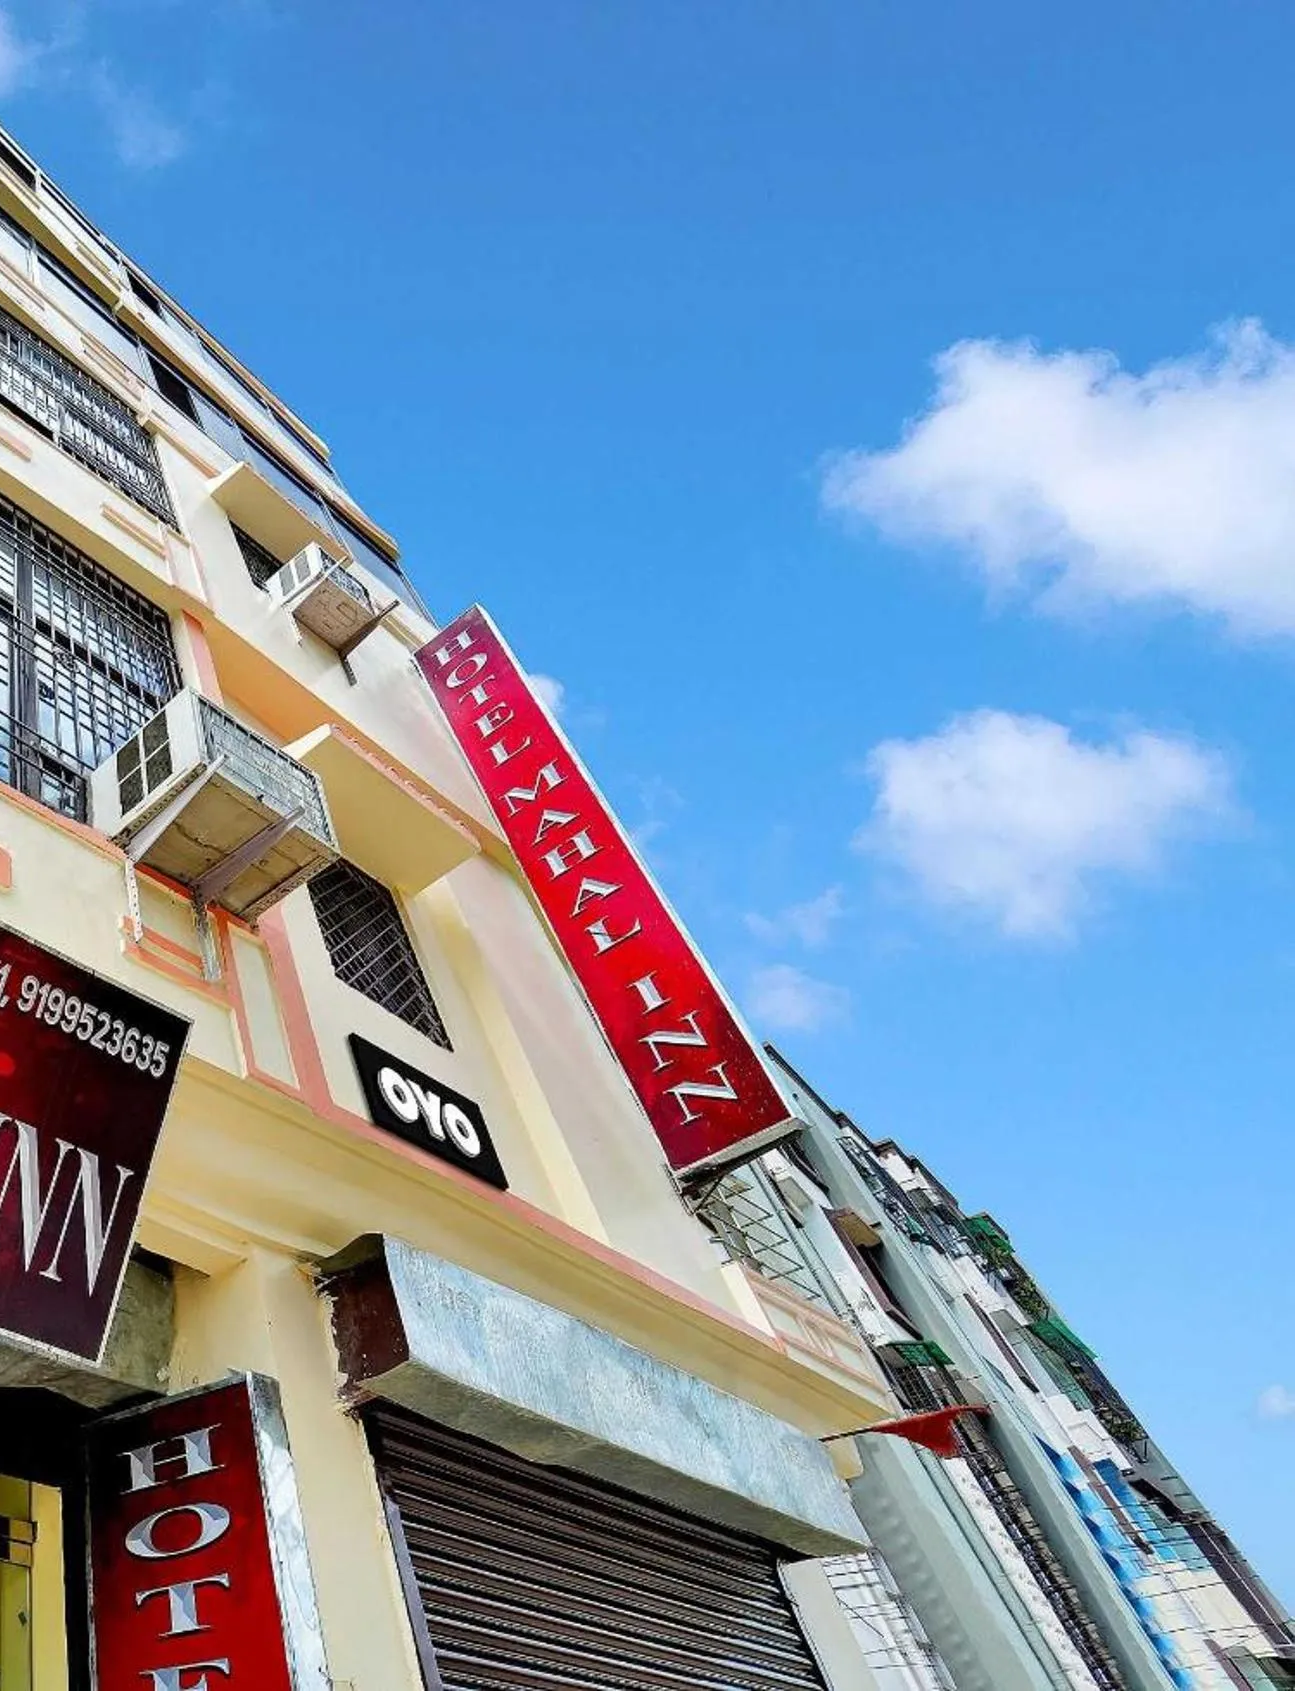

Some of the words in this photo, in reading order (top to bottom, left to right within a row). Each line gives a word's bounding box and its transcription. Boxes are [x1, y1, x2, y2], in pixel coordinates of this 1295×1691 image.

[431, 628, 530, 767] HOTEL
[500, 761, 641, 956] MAHAL
[626, 971, 738, 1126] INN
[17, 975, 170, 1078] 9199523635
[377, 1066, 482, 1158] OYO
